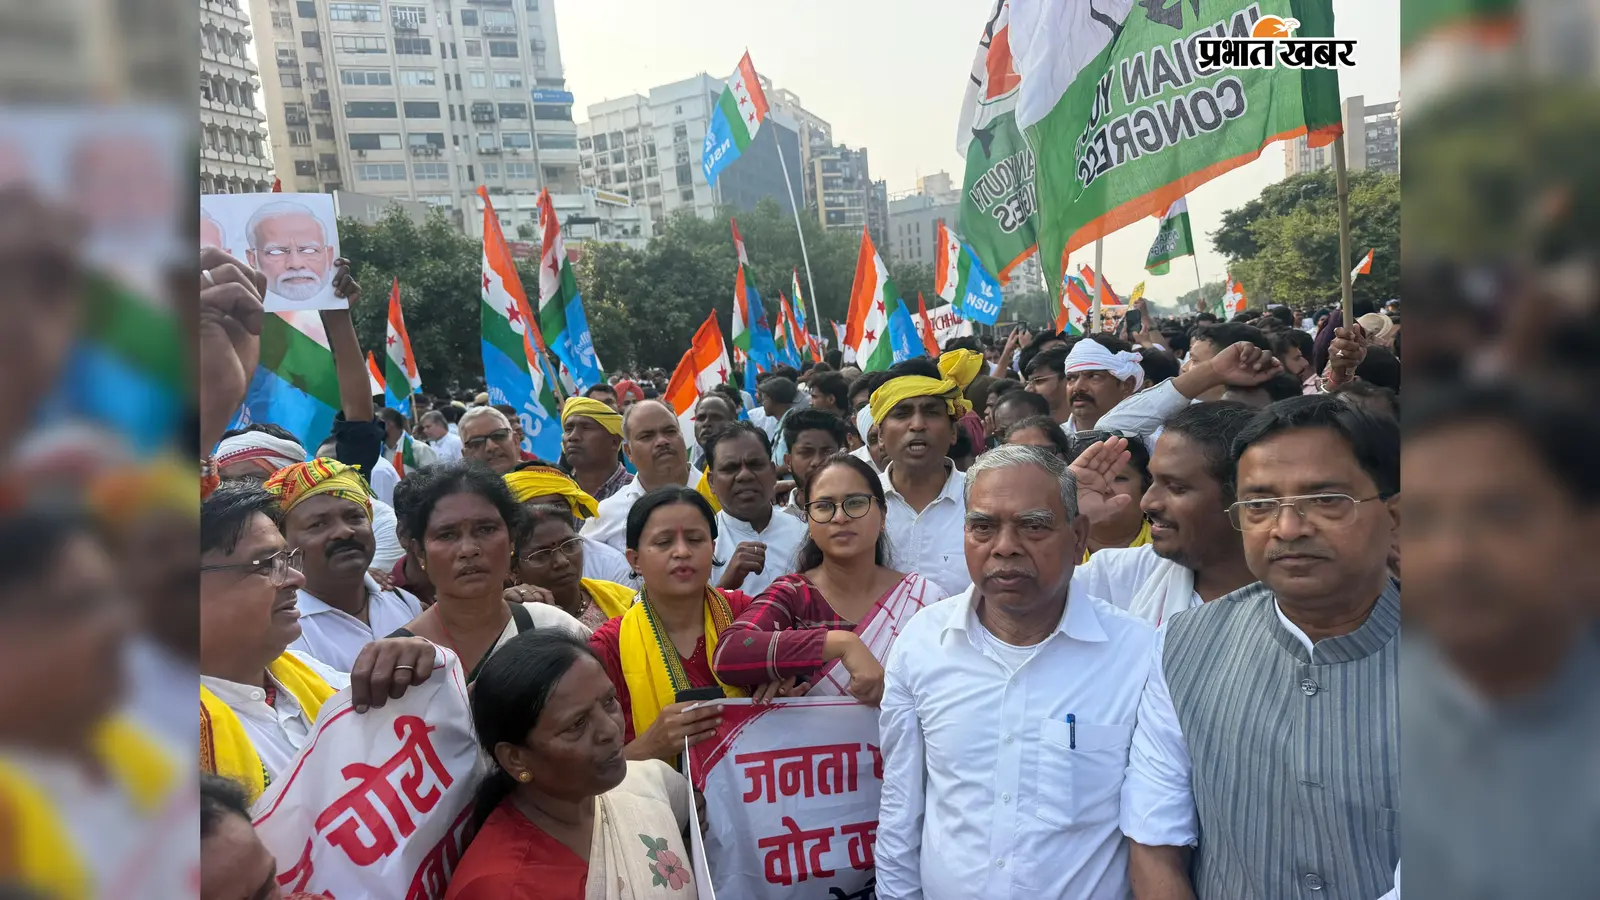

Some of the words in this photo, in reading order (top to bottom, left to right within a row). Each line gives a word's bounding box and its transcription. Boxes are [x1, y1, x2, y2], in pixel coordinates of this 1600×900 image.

[966, 292, 998, 316] NSUI
[314, 714, 455, 867] चोरी
[735, 742, 862, 804] जनता
[758, 816, 835, 887] वोट
